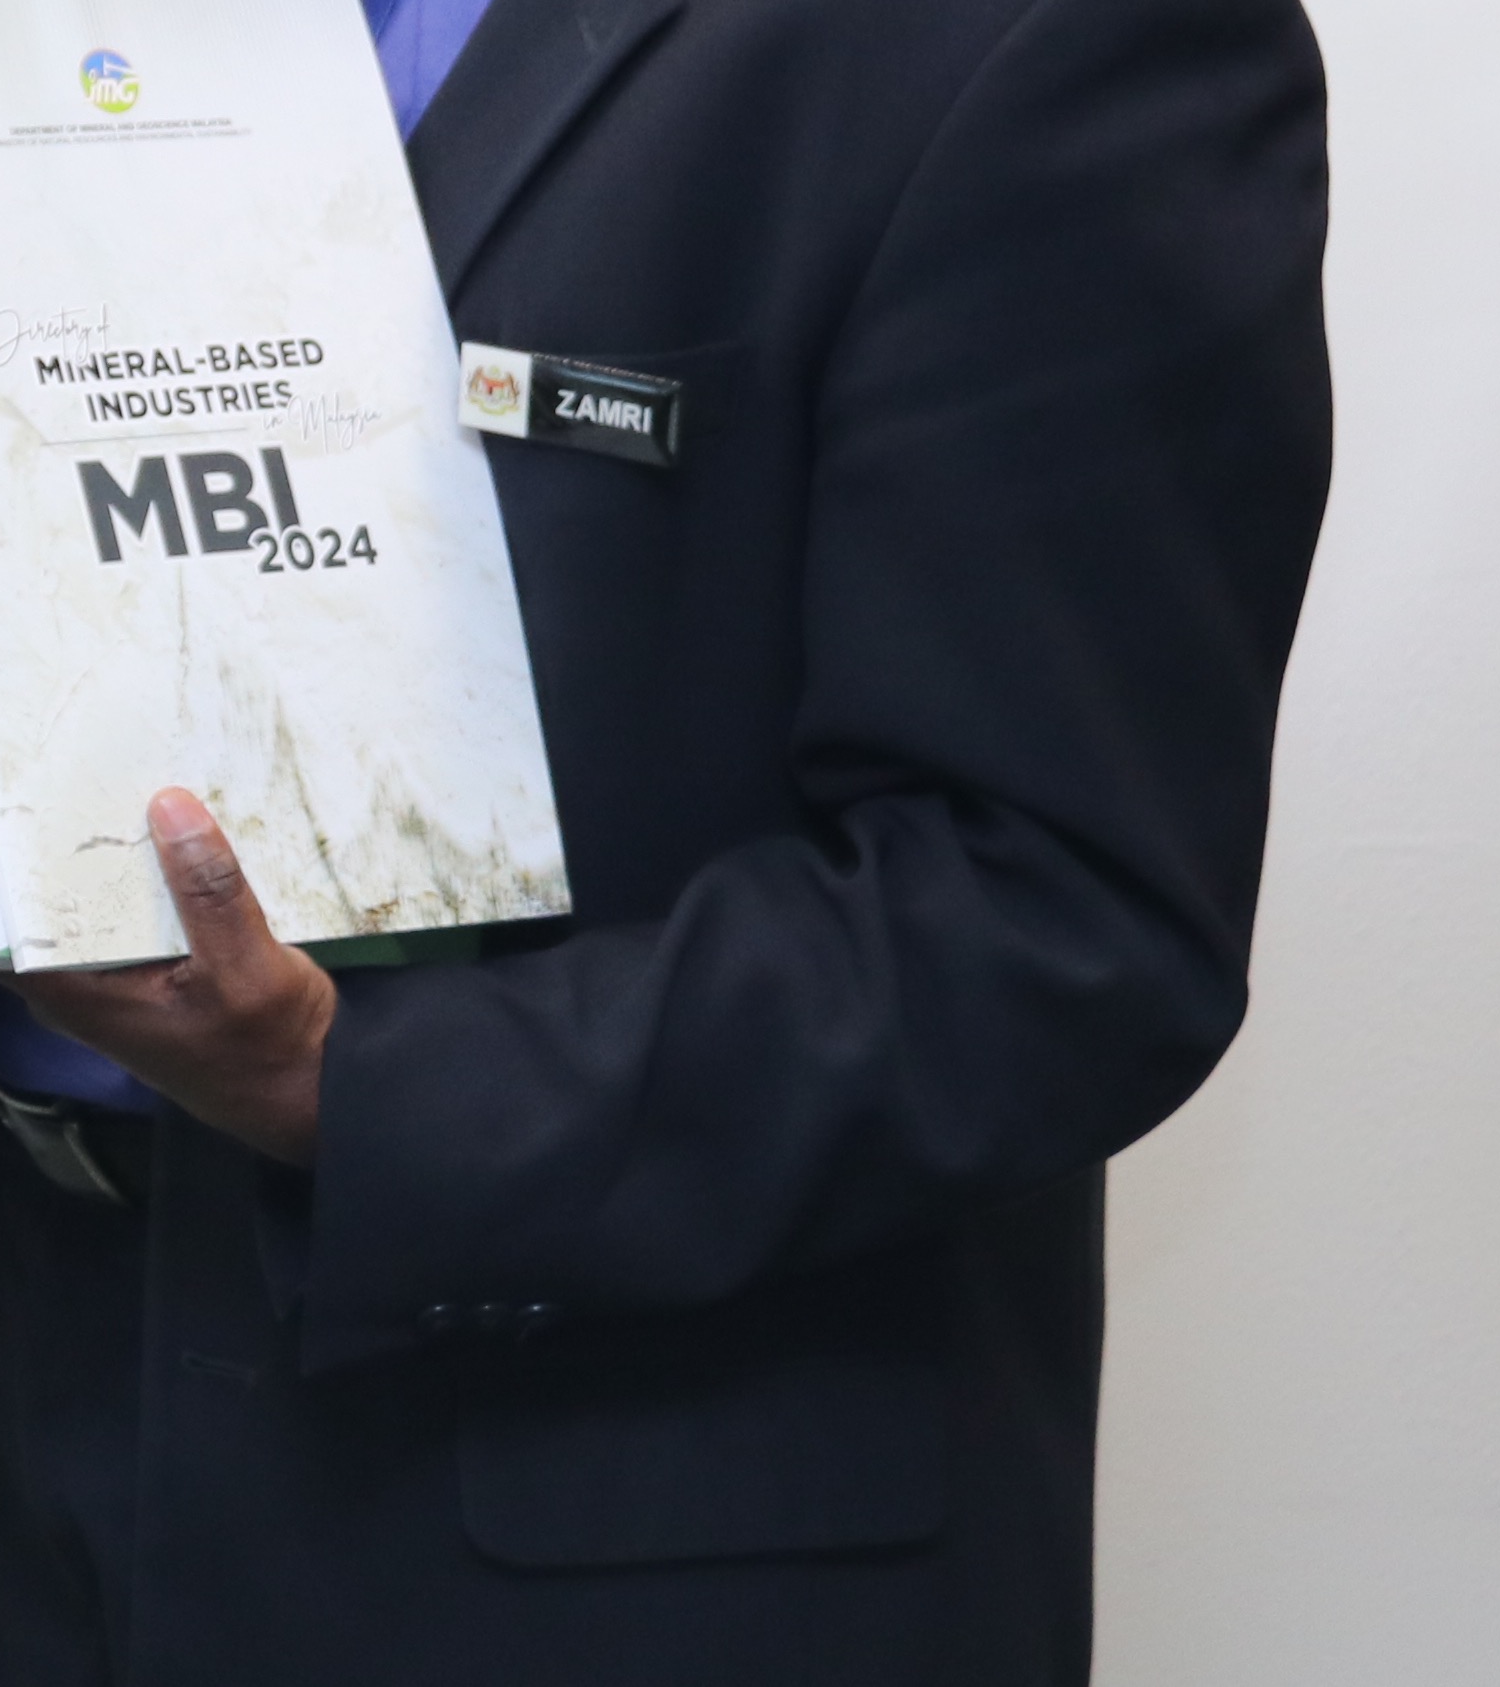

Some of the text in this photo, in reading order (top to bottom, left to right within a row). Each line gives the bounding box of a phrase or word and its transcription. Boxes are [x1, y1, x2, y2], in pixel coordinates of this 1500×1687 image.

[95, 302, 112, 352] of
[33, 337, 326, 386] MINERAL-BASED
[86, 380, 293, 423] INDUSTRIES
[262, 393, 384, 454] in Malaysia
[555, 389, 653, 434] ZAMRI
[77, 445, 301, 564] MBI
[249, 525, 378, 575] 2024
